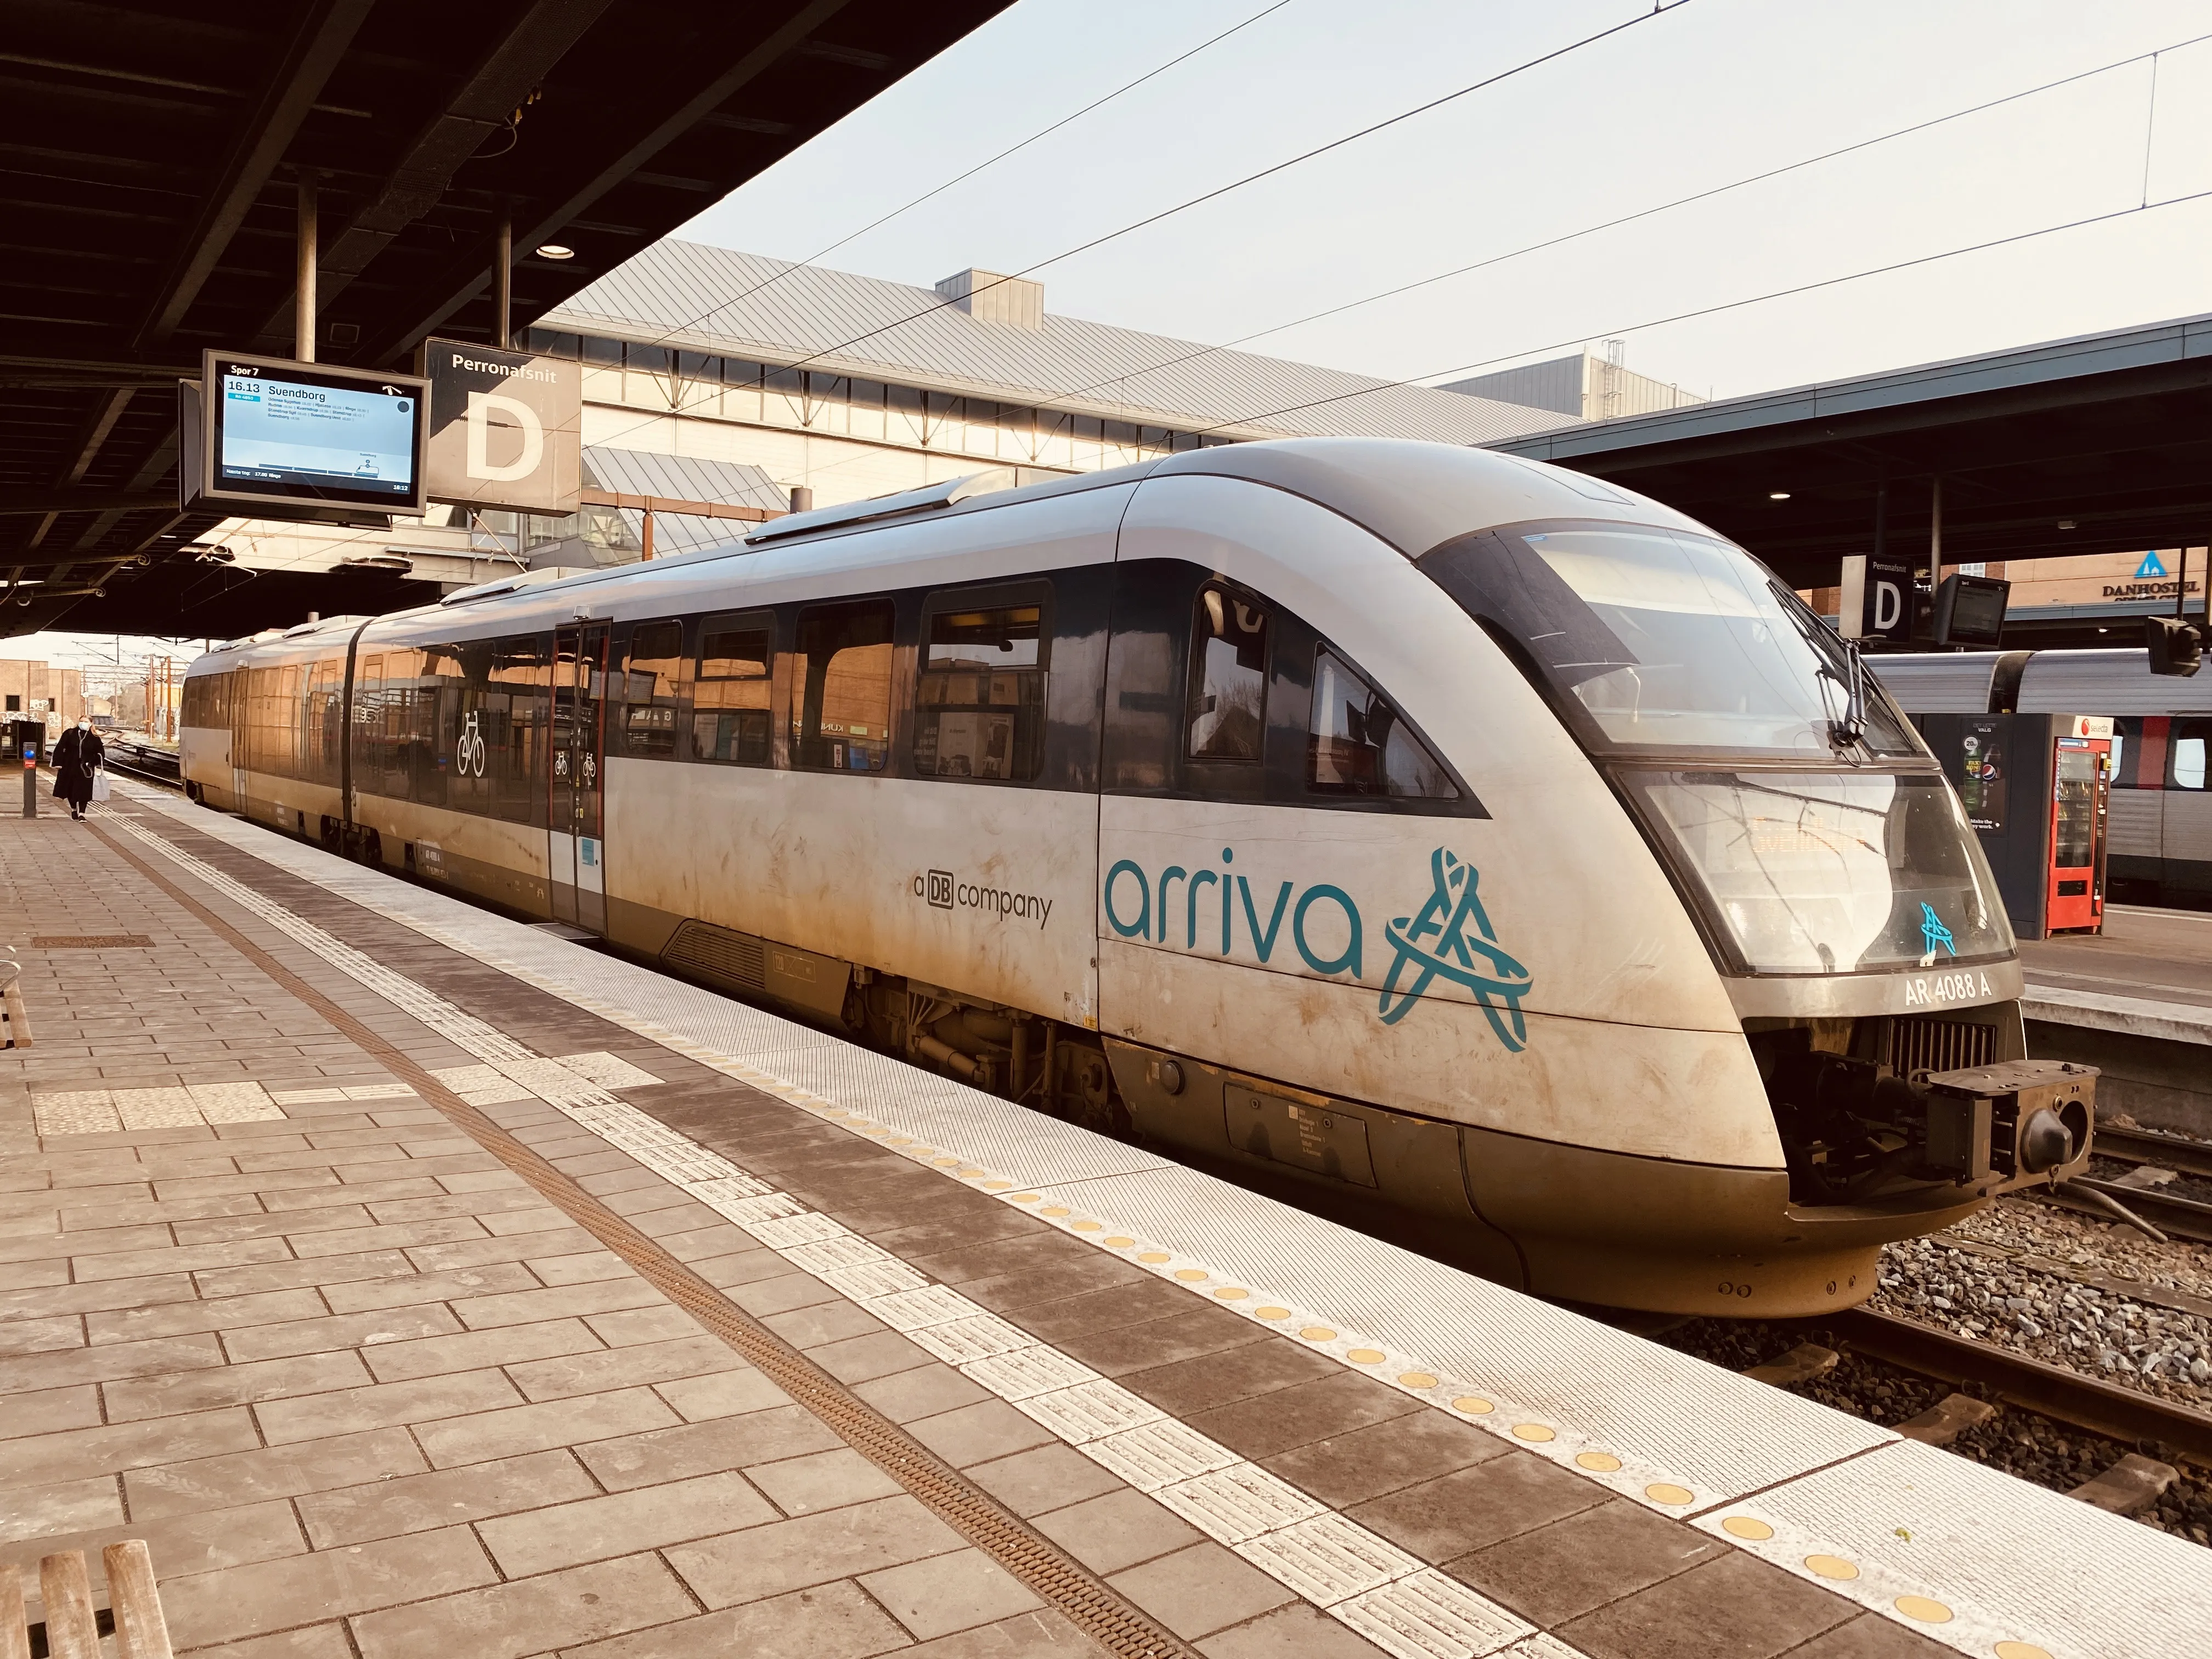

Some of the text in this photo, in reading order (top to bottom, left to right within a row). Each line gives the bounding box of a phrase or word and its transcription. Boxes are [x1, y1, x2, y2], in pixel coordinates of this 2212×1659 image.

[231, 365, 251, 375] Spor
[452, 354, 557, 383] Perronafsnit
[228, 381, 325, 402] 16.13 Svendborg
[467, 391, 544, 482] D
[1873, 561, 1906, 573] Perronafsnit
[2103, 581, 2200, 596] DANHOSTEL
[1875, 581, 1901, 629] D
[914, 874, 1052, 930] a DB company
[1104, 847, 1363, 980] arriva
[1906, 972, 1992, 1006] AR 4088 A
